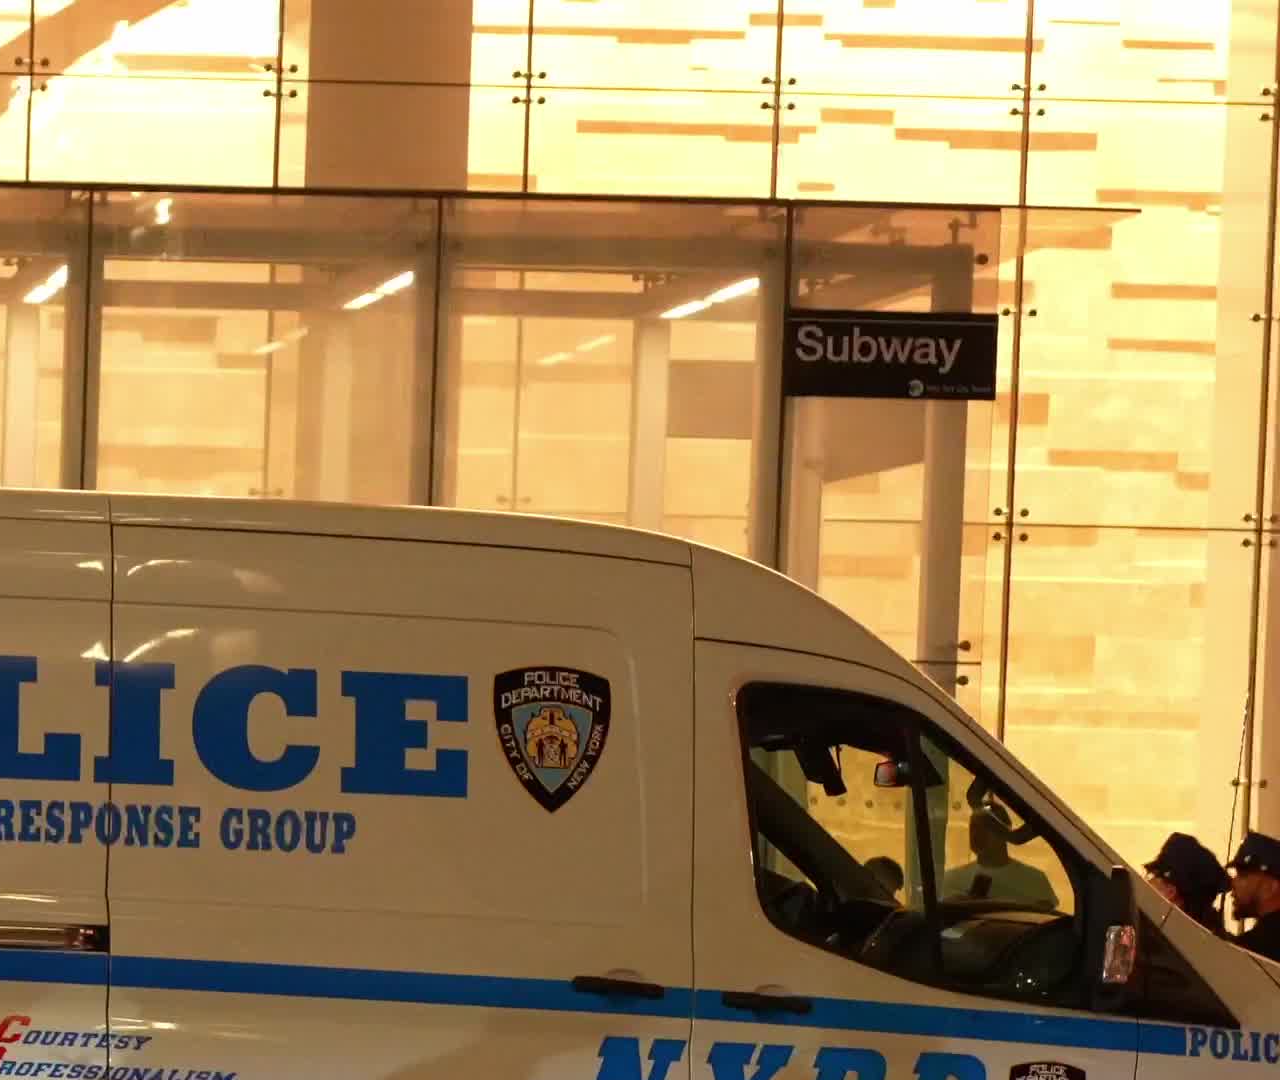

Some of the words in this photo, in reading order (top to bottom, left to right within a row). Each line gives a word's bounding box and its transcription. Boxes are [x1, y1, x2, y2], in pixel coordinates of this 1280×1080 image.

[795, 324, 962, 374] Subway
[524, 671, 580, 688] POLICE
[500, 685, 603, 712] DEPARTMENT
[220, 807, 357, 855] GROUP
